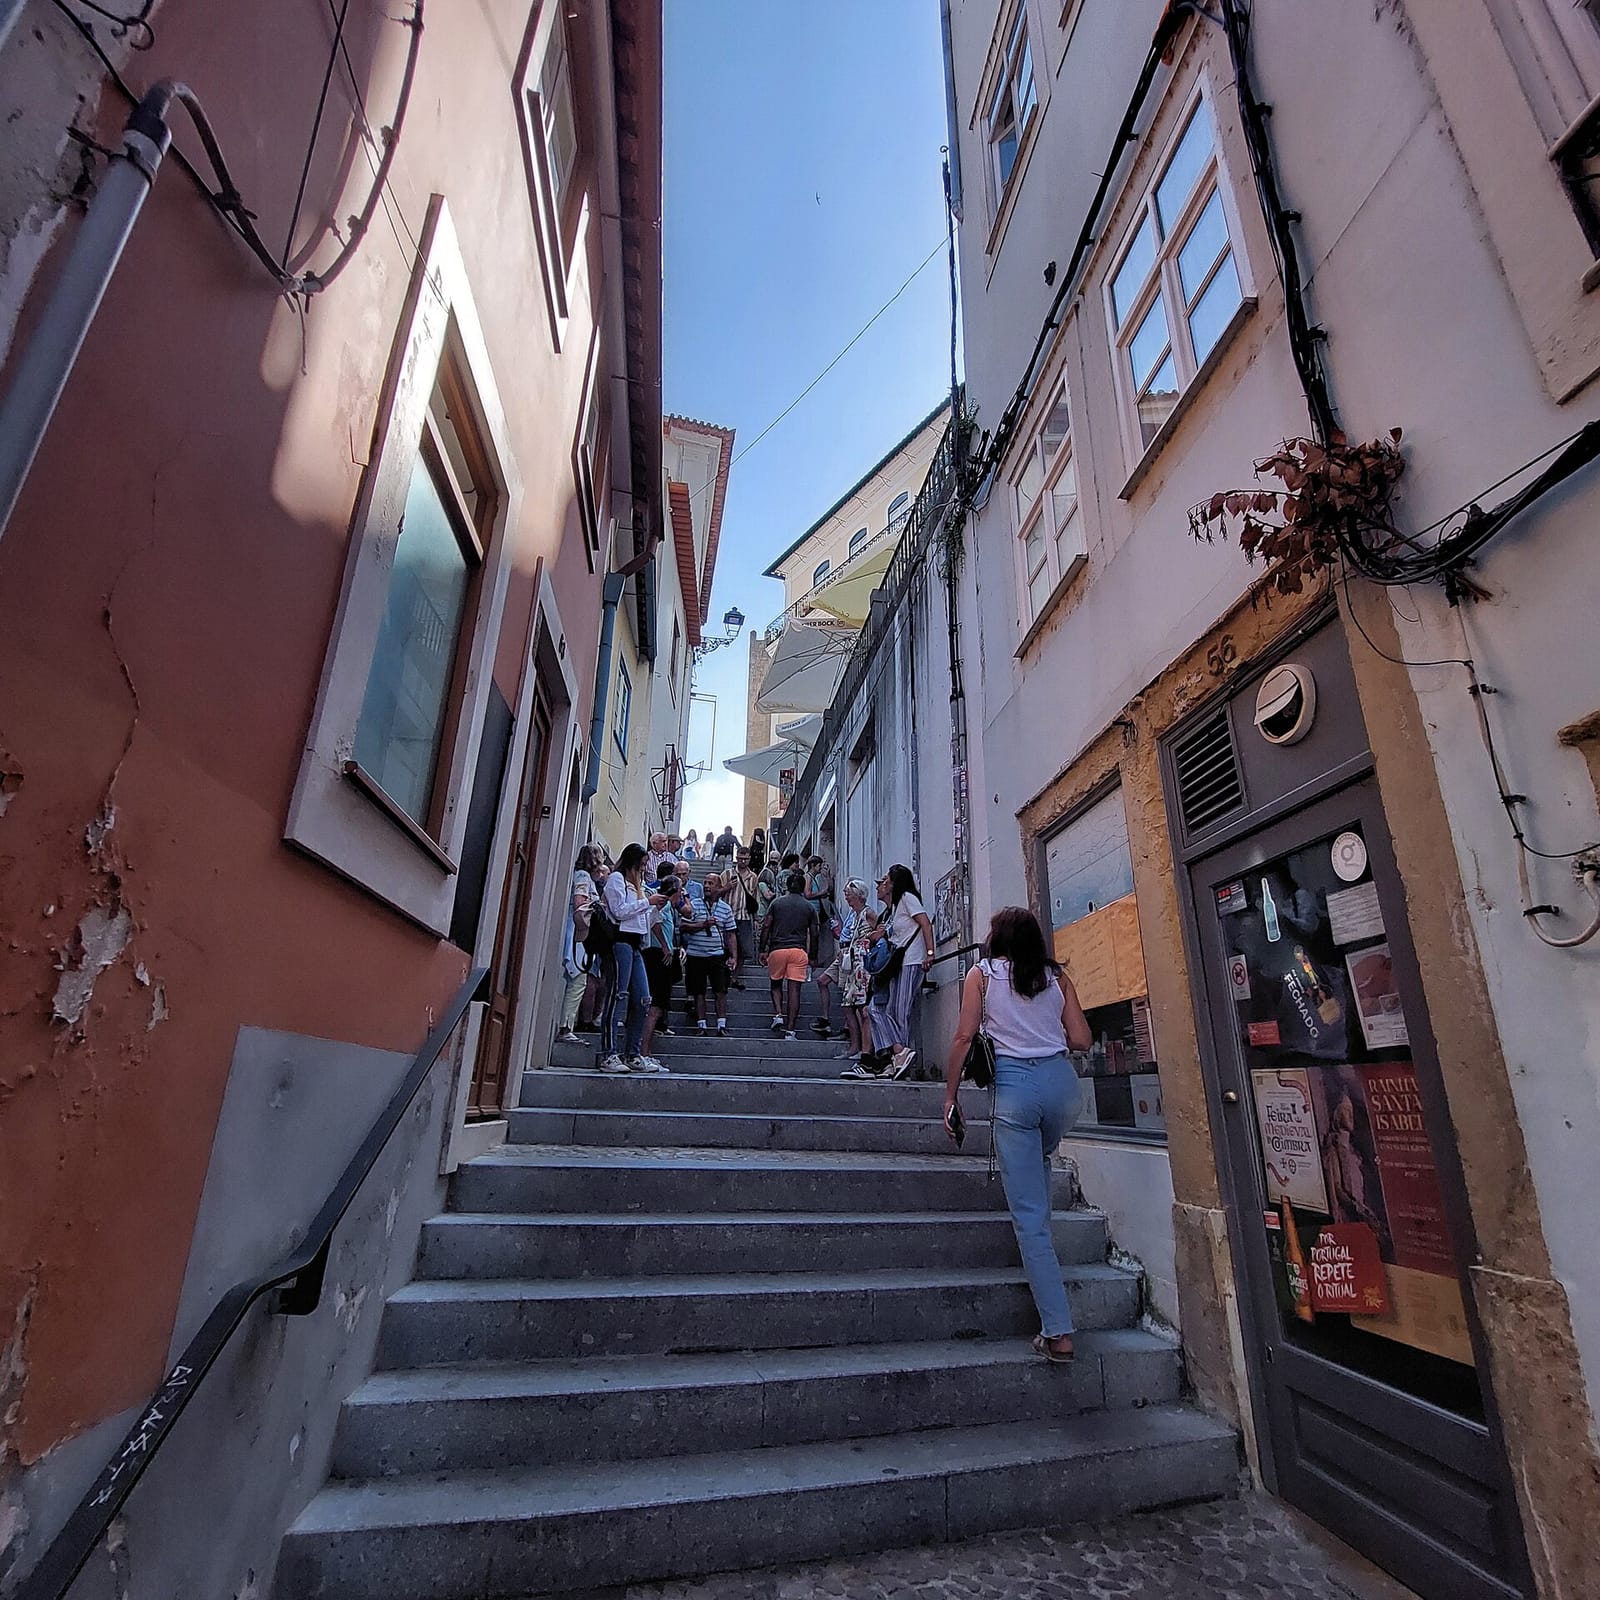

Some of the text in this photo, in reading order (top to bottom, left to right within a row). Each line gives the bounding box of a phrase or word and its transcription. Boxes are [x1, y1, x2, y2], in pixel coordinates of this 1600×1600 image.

[1207, 634, 1237, 675] 56
[1283, 972, 1320, 1039] FECHADO
[1371, 1094, 1425, 1112] SANTA
[1318, 1232, 1337, 1245] POR
[1311, 1262, 1357, 1285] REPETE
[1317, 1283, 1325, 1299] O
[1325, 1282, 1358, 1299] RITUAL
